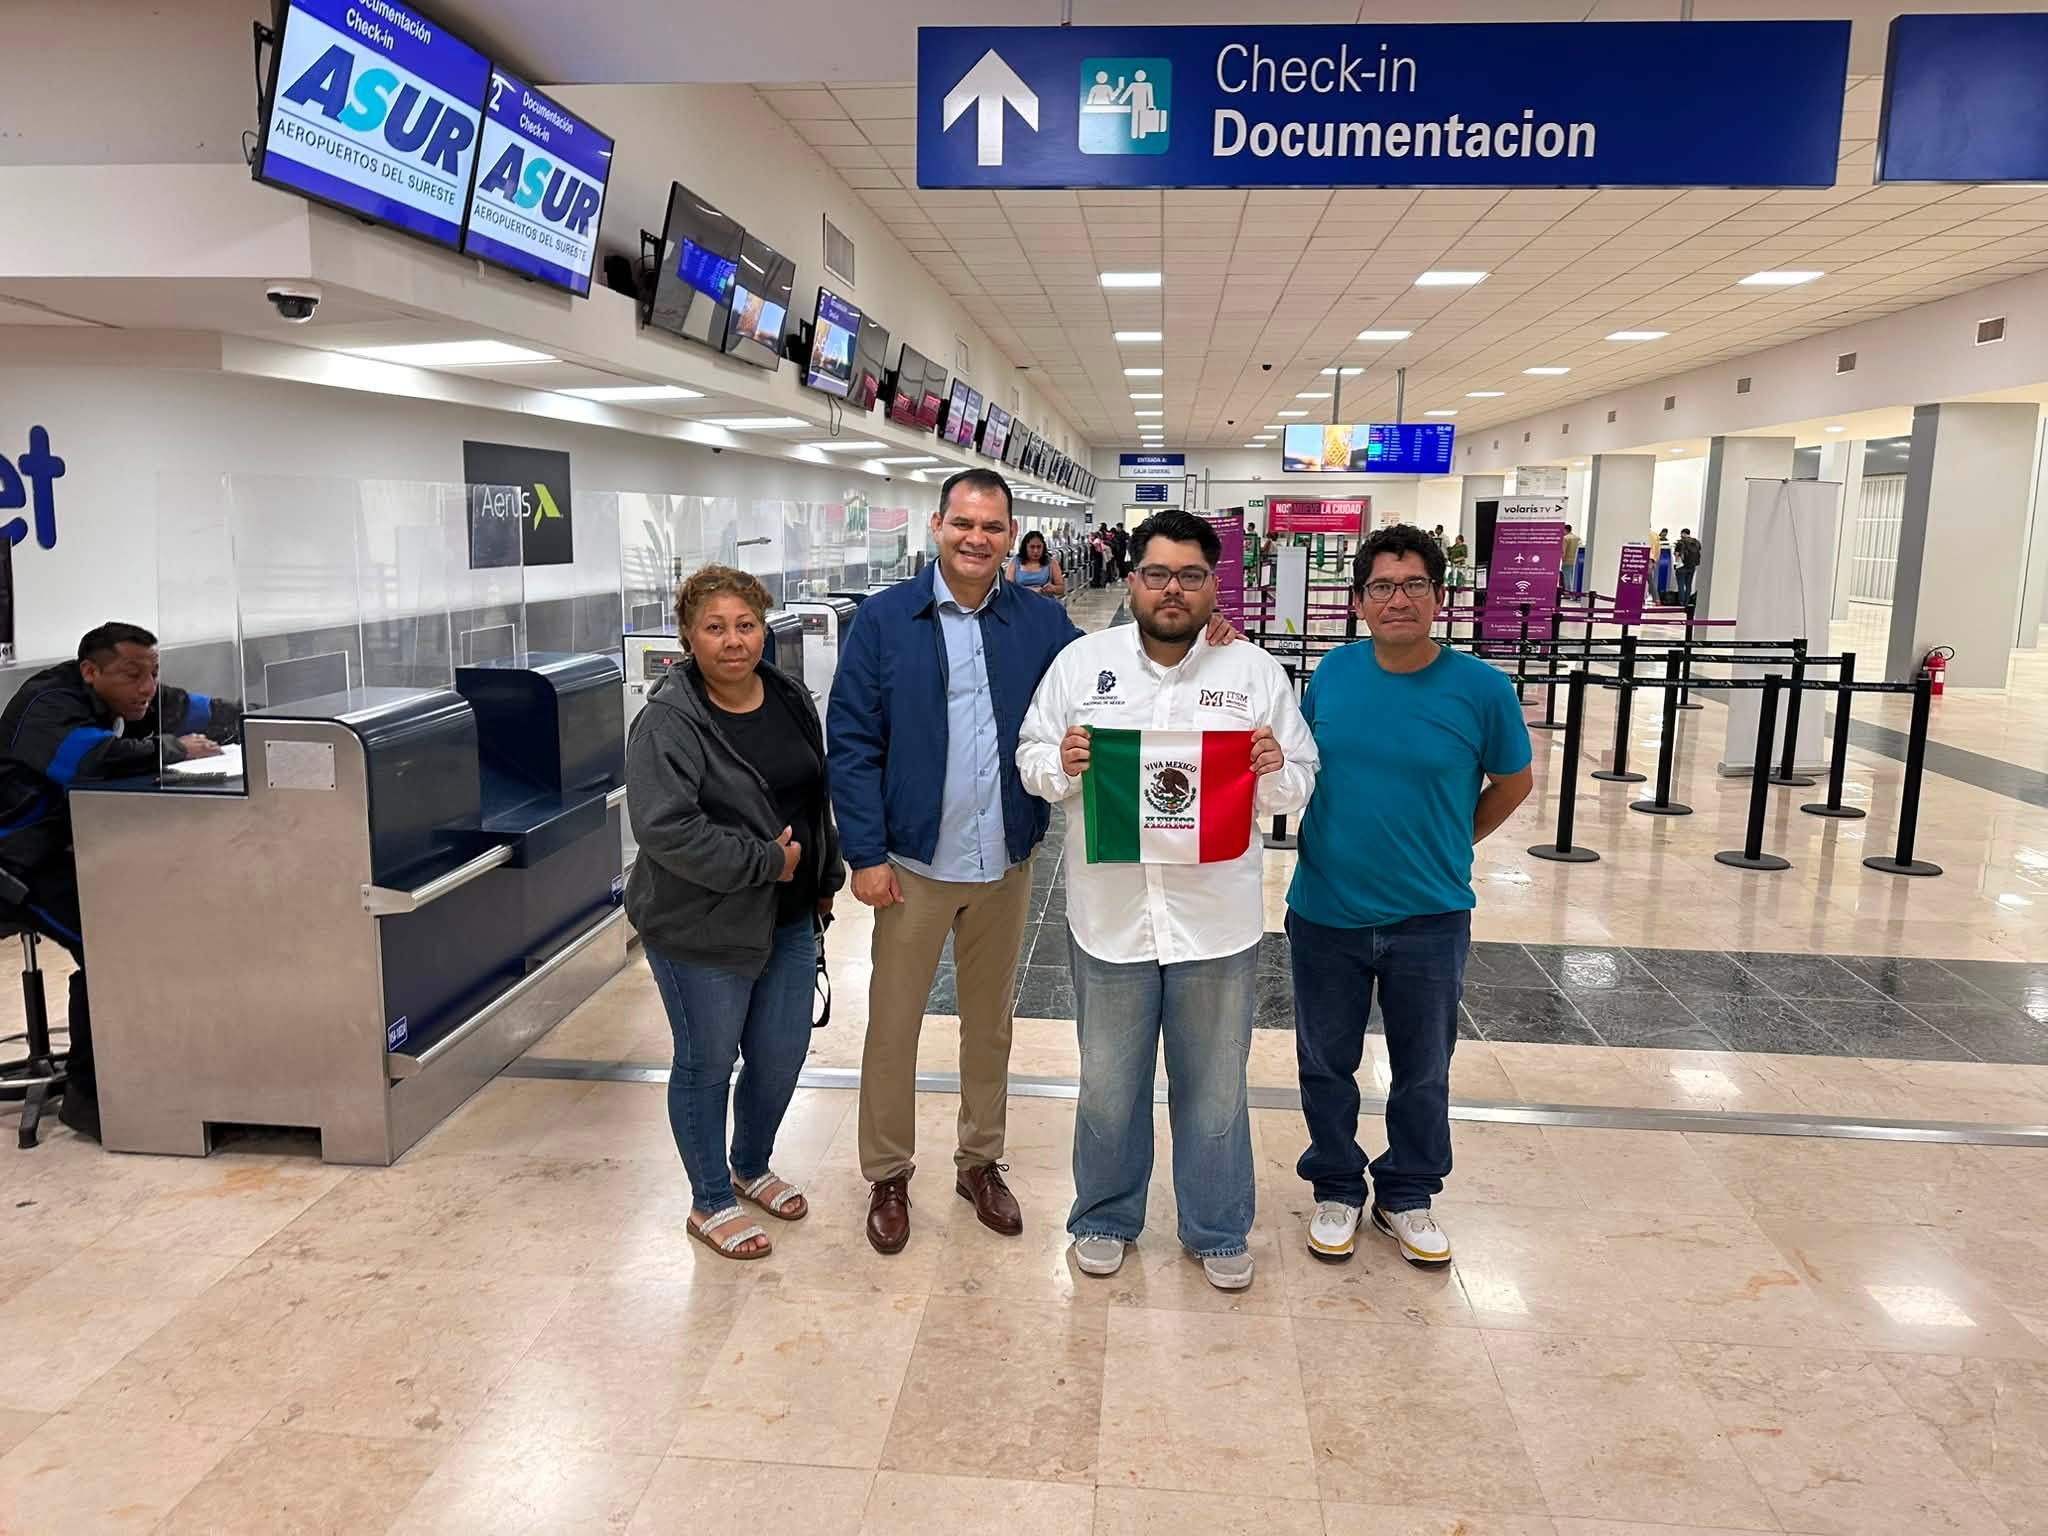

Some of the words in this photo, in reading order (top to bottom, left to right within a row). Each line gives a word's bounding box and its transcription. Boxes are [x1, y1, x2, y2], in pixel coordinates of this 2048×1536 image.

[346, 7, 394, 51] Check-in
[359, 0, 431, 45] cumentación
[1216, 43, 1417, 93] Check-in
[282, 44, 475, 177] ASUR
[519, 114, 550, 143] Check-in
[522, 91, 574, 136] Documentación
[1213, 109, 1596, 158] Documentacion
[275, 117, 379, 173] AEROPUERTOS
[381, 163, 404, 184] DEL
[407, 175, 456, 206] SURESTE
[478, 142, 601, 238] ASUR
[474, 204, 538, 241] AEROPUERTOS
[539, 231, 554, 248] DEL
[555, 238, 588, 262] SURESTE
[481, 487, 531, 518] Aerus
[1275, 503, 1292, 514] NOS
[1321, 503, 1331, 514] LA
[1332, 503, 1361, 514] CIUDAD
[1504, 504, 1538, 513] volaris
[1144, 761, 1164, 771] VIVA
[1165, 761, 1197, 773] MEXICO
